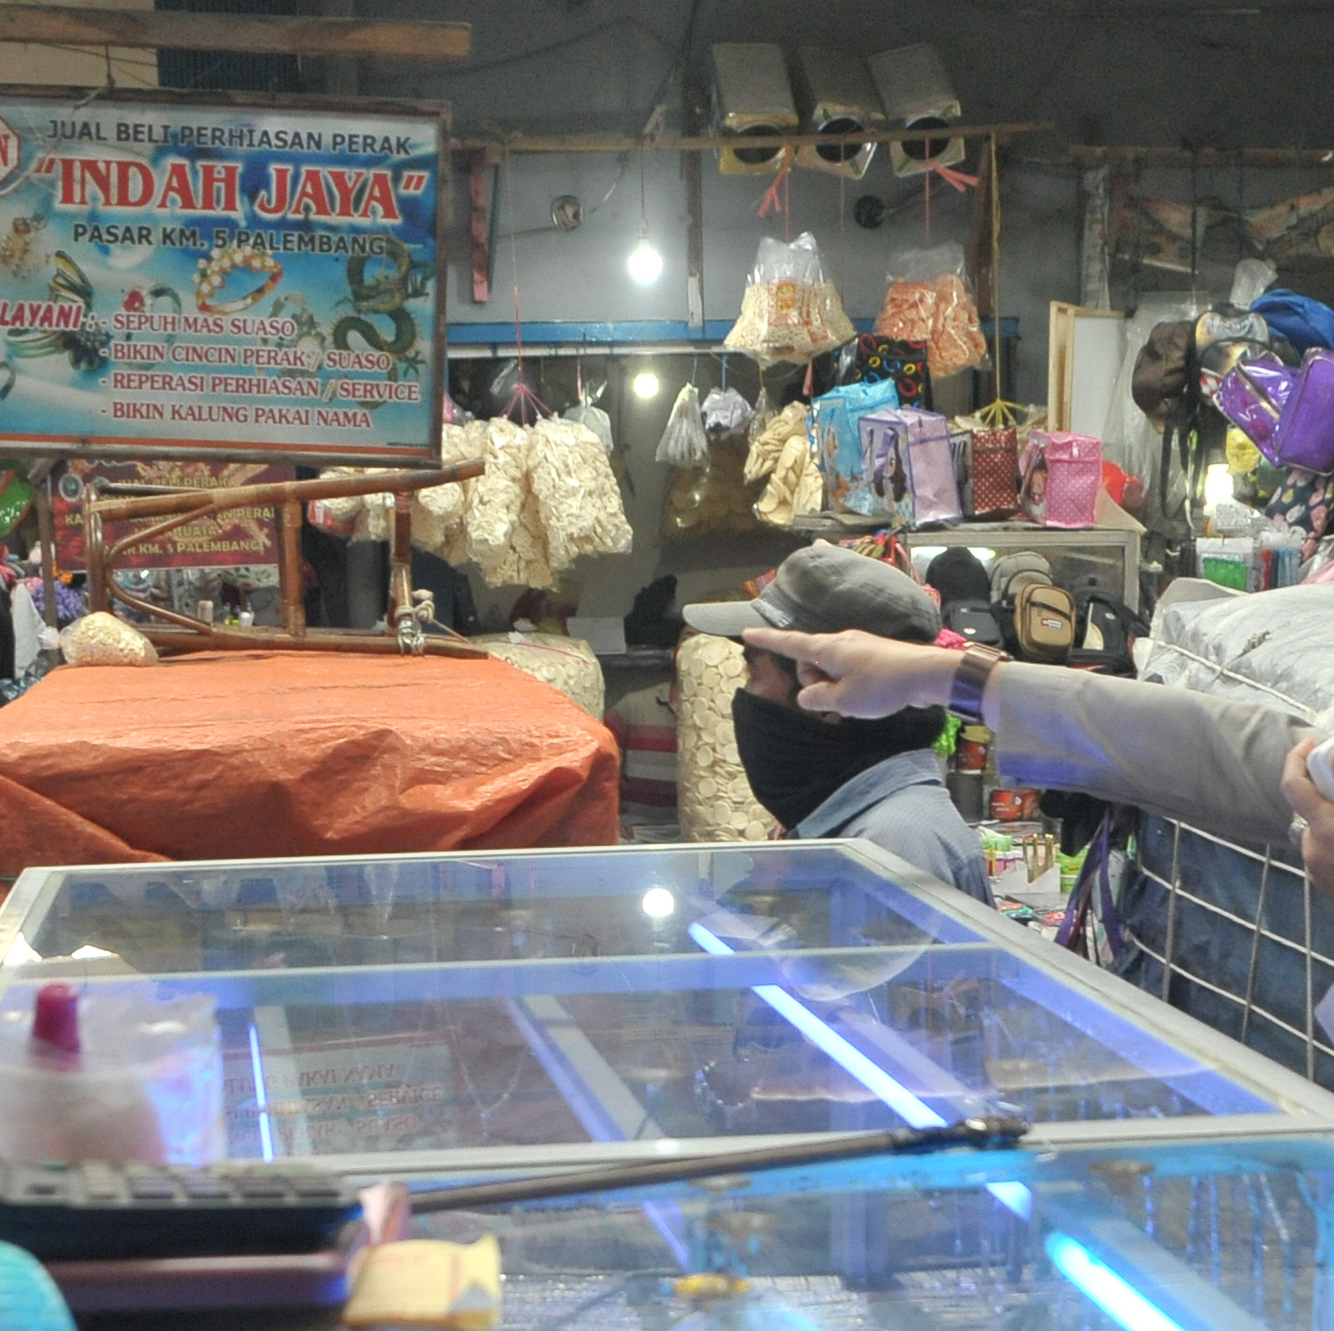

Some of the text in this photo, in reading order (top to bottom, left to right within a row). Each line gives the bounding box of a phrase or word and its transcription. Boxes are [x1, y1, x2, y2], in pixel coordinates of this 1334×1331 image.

[46, 119, 412, 155] JUAL BELI PERHIASAN PERAK
[73, 223, 386, 257] PASAR KM. 5 PALEMBANG
[113, 314, 297, 337] SEPUH MAS SUASO
[112, 343, 166, 361] BIKIN
[171, 345, 237, 364] CINCIN
[242, 348, 307, 368] PERAK
[326, 351, 392, 371] SUASO
[113, 373, 205, 392] REPERASI
[211, 376, 319, 396] PERHIASAN
[339, 381, 420, 401] SERVICE
[112, 402, 372, 428] BIKIN KALUNG PAKAI NAMA
[138, 544, 164, 555] KM.
[176, 540, 261, 553] PALEMBANG
